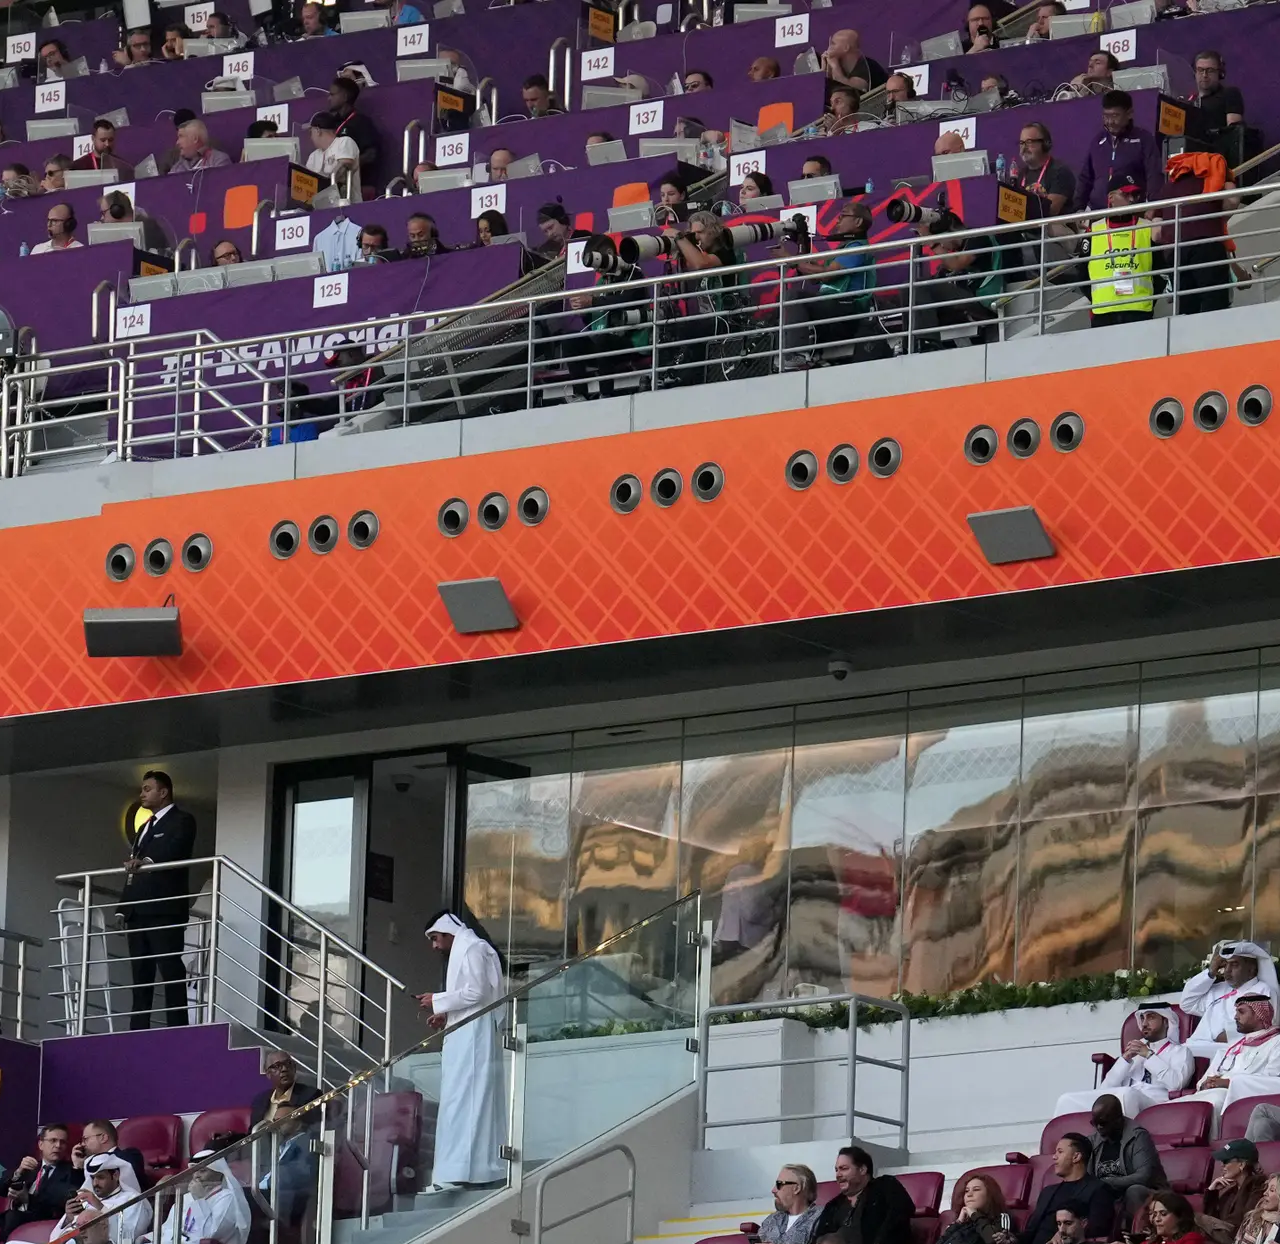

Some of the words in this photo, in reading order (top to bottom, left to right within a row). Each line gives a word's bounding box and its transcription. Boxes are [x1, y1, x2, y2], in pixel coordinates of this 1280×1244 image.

[191, 11, 207, 23] 151
[781, 23, 803, 37] 143
[403, 33, 423, 46] 147
[12, 41, 30, 53] 150
[1106, 39, 1129, 54] 168
[229, 61, 248, 73] 146
[587, 57, 608, 70] 142
[40, 91, 60, 103] 145
[636, 111, 657, 124] 137
[442, 143, 463, 156] 136
[736, 160, 759, 174] 163
[478, 194, 499, 207] 131
[281, 226, 304, 239] 130
[320, 283, 341, 297] 125
[122, 315, 144, 328] 124
